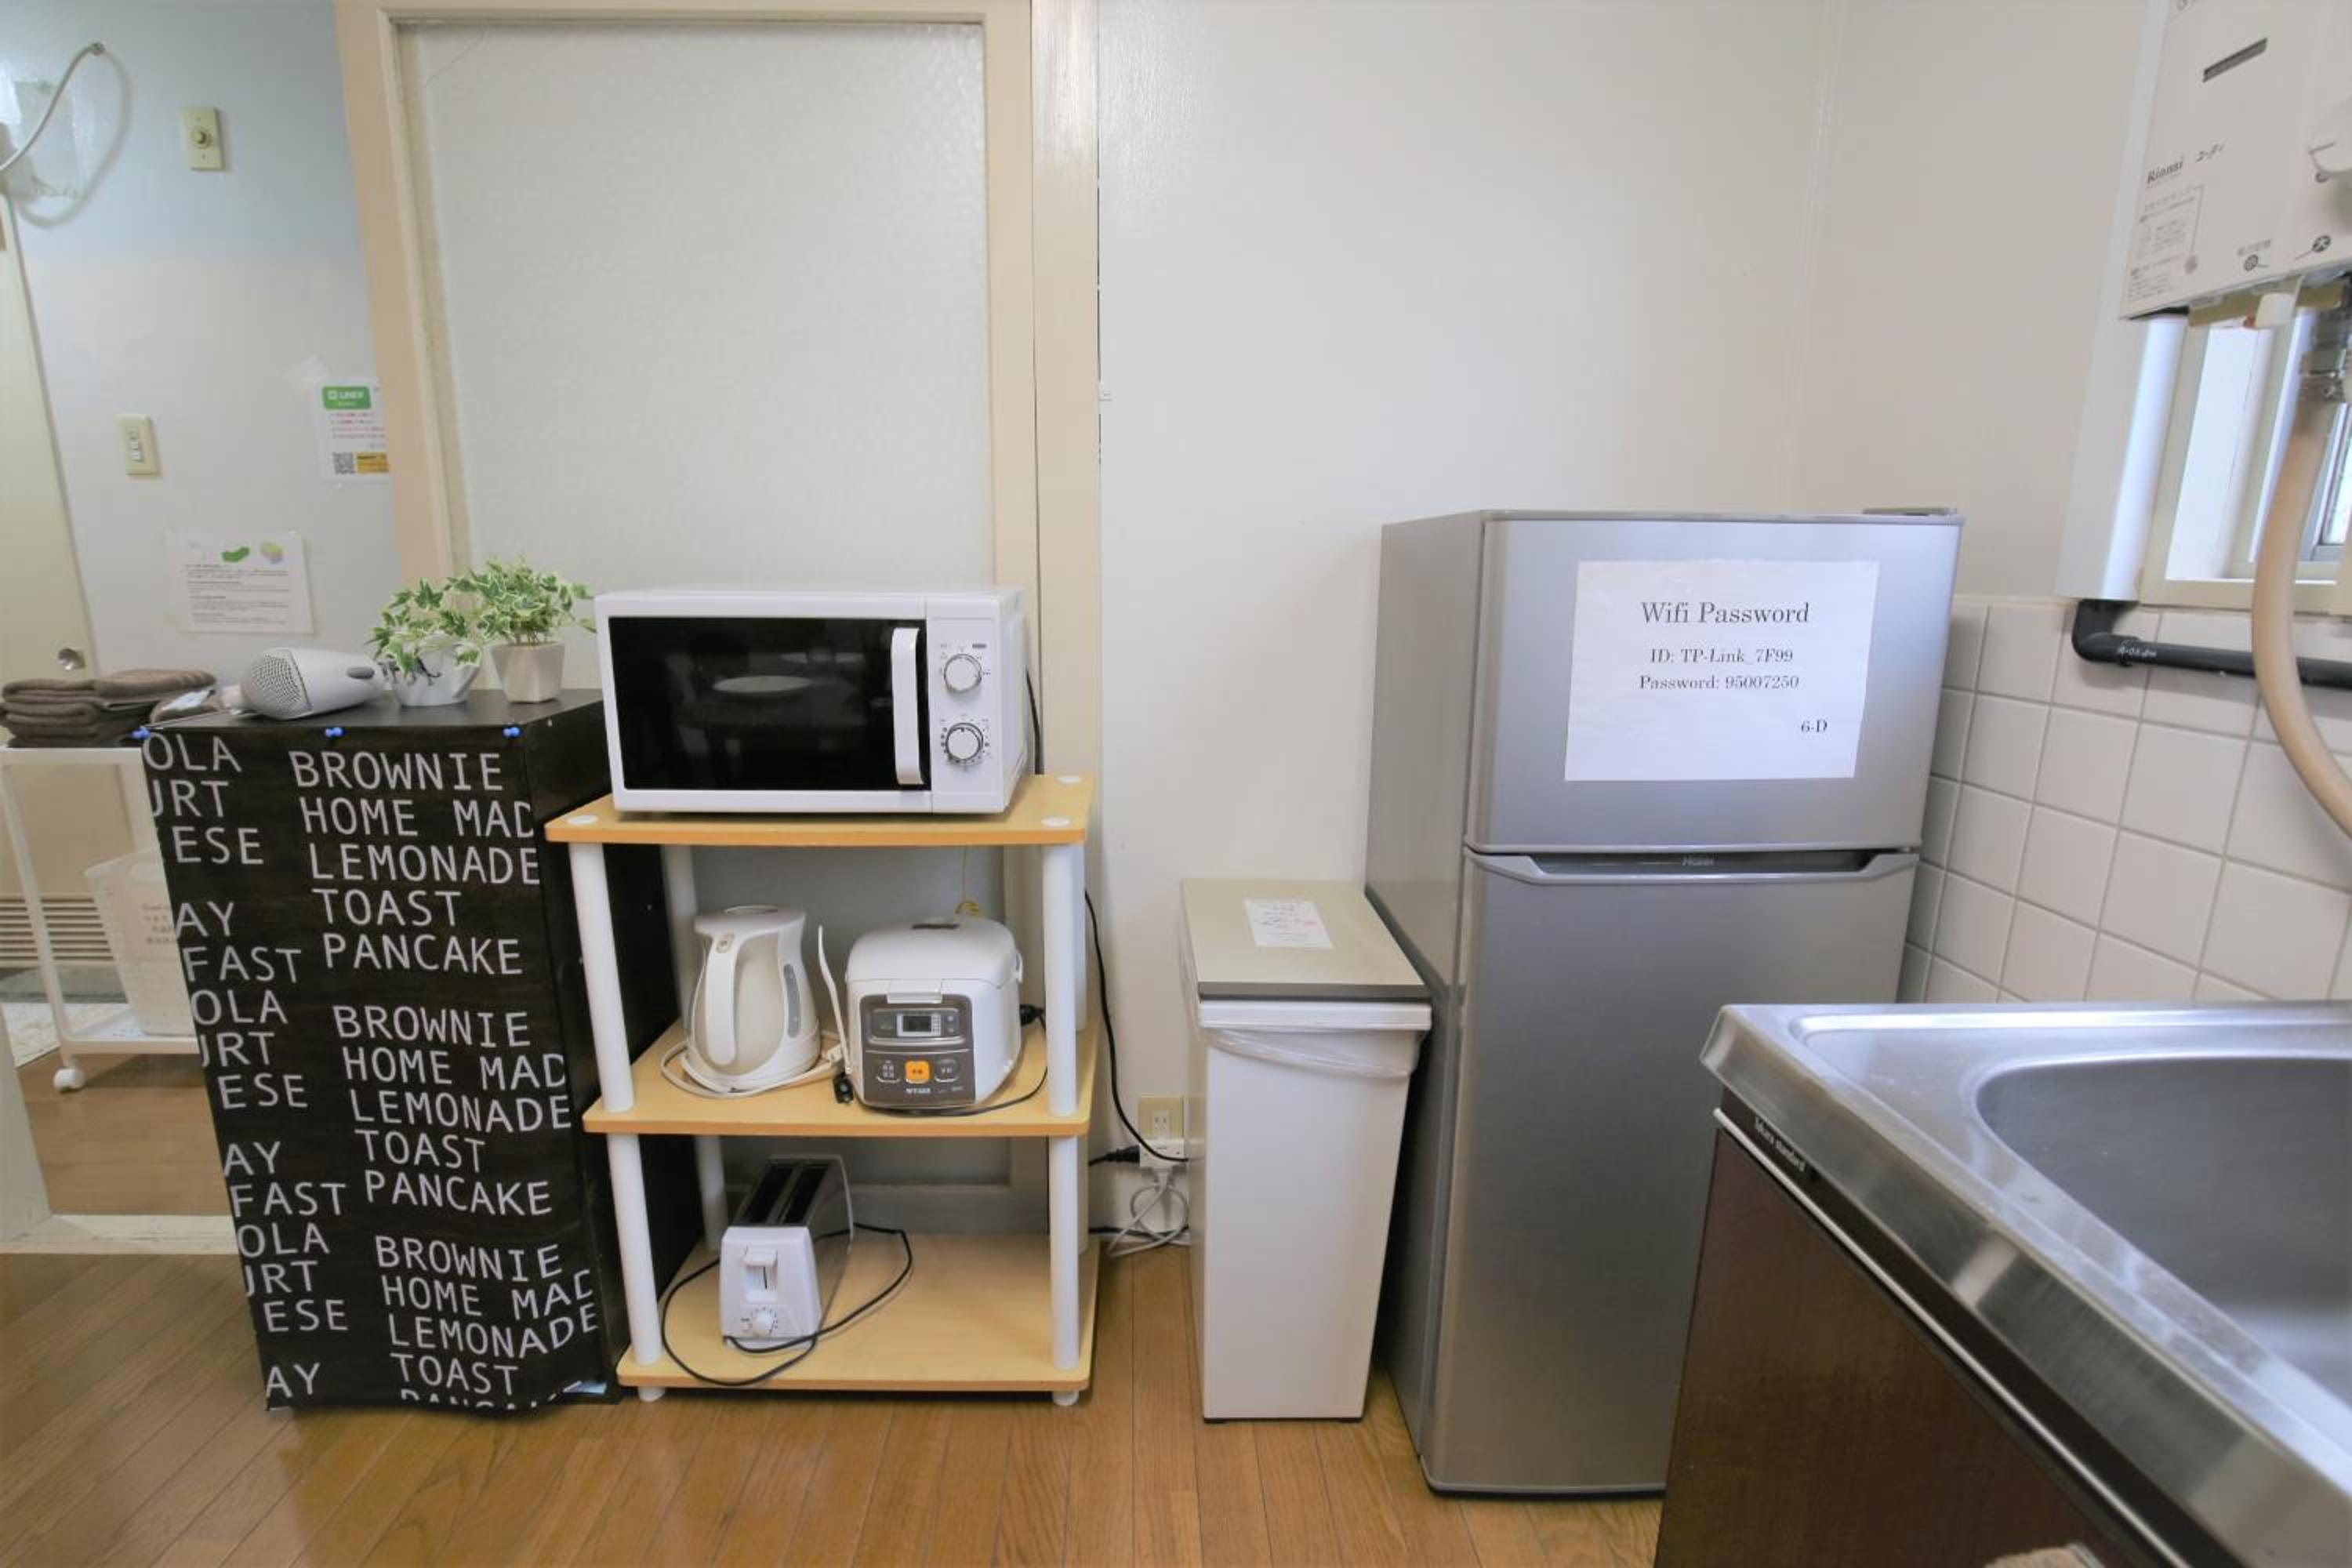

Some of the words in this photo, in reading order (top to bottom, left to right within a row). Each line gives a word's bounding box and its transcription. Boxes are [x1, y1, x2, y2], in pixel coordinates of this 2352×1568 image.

[1642, 601, 1690, 623] Wifi
[1699, 601, 1810, 624] Password
[1650, 648, 1675, 663] ID:
[1639, 674, 1720, 690] Password:
[1725, 675, 1800, 690] 95007250
[1800, 720, 1828, 734] 6-D
[142, 731, 242, 772] OLA
[287, 750, 504, 791] BROWNIE
[298, 796, 419, 837] HOME
[452, 799, 535, 839] MAD
[171, 826, 265, 865] ESE
[308, 842, 541, 885] LEMONADE
[176, 901, 235, 938] AY
[310, 887, 463, 927] TOAST
[181, 946, 303, 983] FAST
[322, 932, 524, 975] PANCAKE
[191, 988, 289, 1025] OLA
[332, 1004, 532, 1048] BROWNIE
[341, 1045, 453, 1085] HOME
[478, 1053, 567, 1091] MAD
[216, 1072, 309, 1109] ESE
[349, 1087, 572, 1133] LEMONADE
[223, 1141, 281, 1177] AY
[354, 1127, 486, 1174] TOAST
[229, 1181, 347, 1218] FAST
[364, 1168, 554, 1217] PANCAKE
[237, 1221, 331, 1259] OLA
[374, 1234, 564, 1283] BROWNIE
[262, 1298, 349, 1333] ESE
[380, 1274, 483, 1317] HOME
[387, 1301, 599, 1359] LEMONADE
[265, 1361, 321, 1399] AY
[389, 1352, 519, 1396] TOAST
